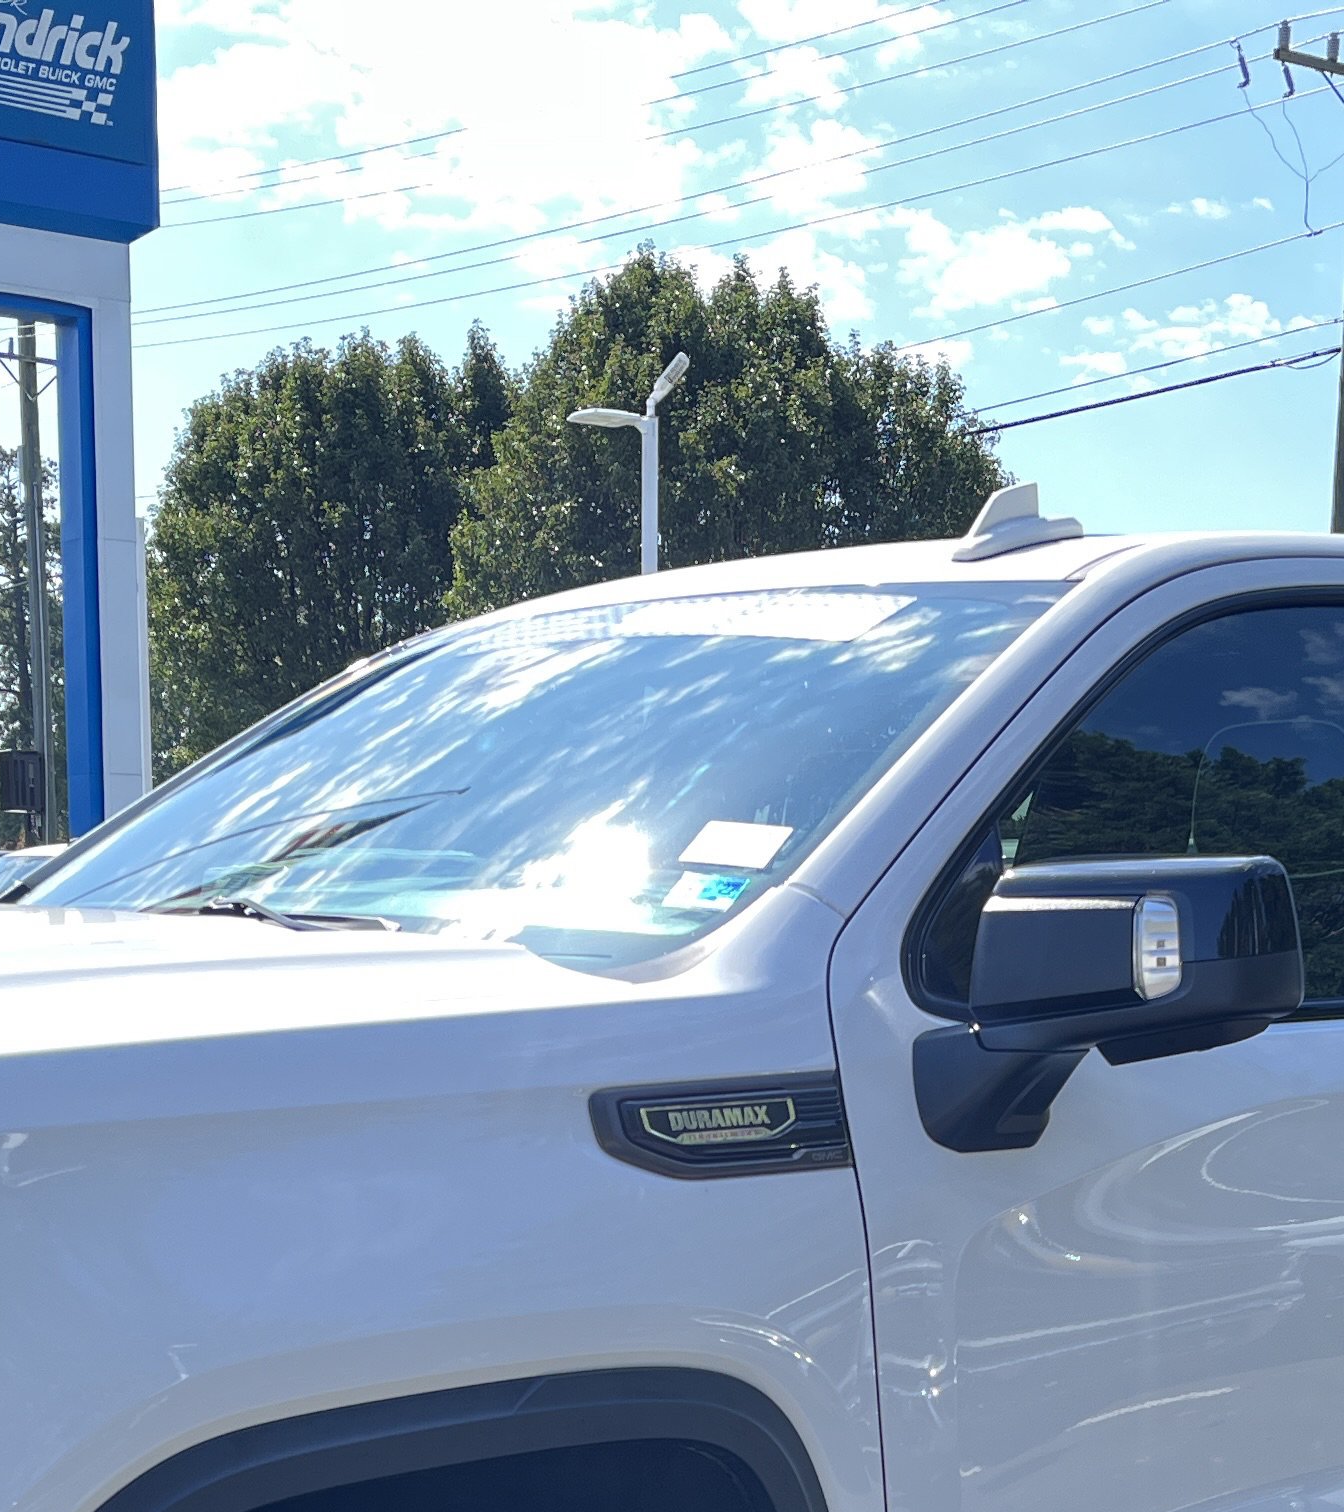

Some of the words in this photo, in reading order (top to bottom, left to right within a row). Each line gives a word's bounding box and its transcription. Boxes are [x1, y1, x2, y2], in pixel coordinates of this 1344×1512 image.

[38, 66, 81, 85] BUICK
[84, 73, 117, 91] GMC
[667, 1104, 772, 1132] DURAMAX
